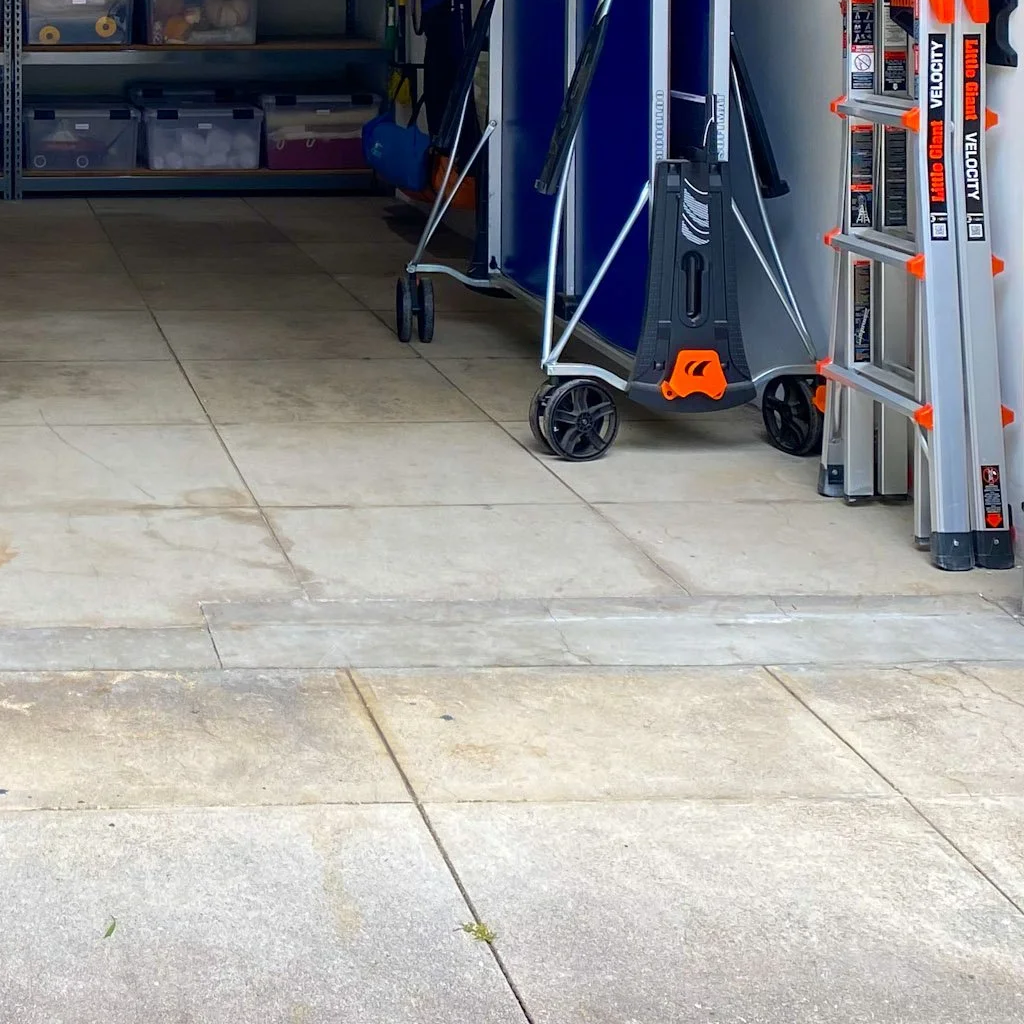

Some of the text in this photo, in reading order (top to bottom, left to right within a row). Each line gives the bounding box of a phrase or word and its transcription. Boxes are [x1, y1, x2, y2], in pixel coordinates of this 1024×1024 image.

[930, 41, 943, 109] VELOCITY
[965, 82, 979, 120] Giant
[929, 120, 943, 159] Giant
[965, 132, 981, 201] VELOCITY
